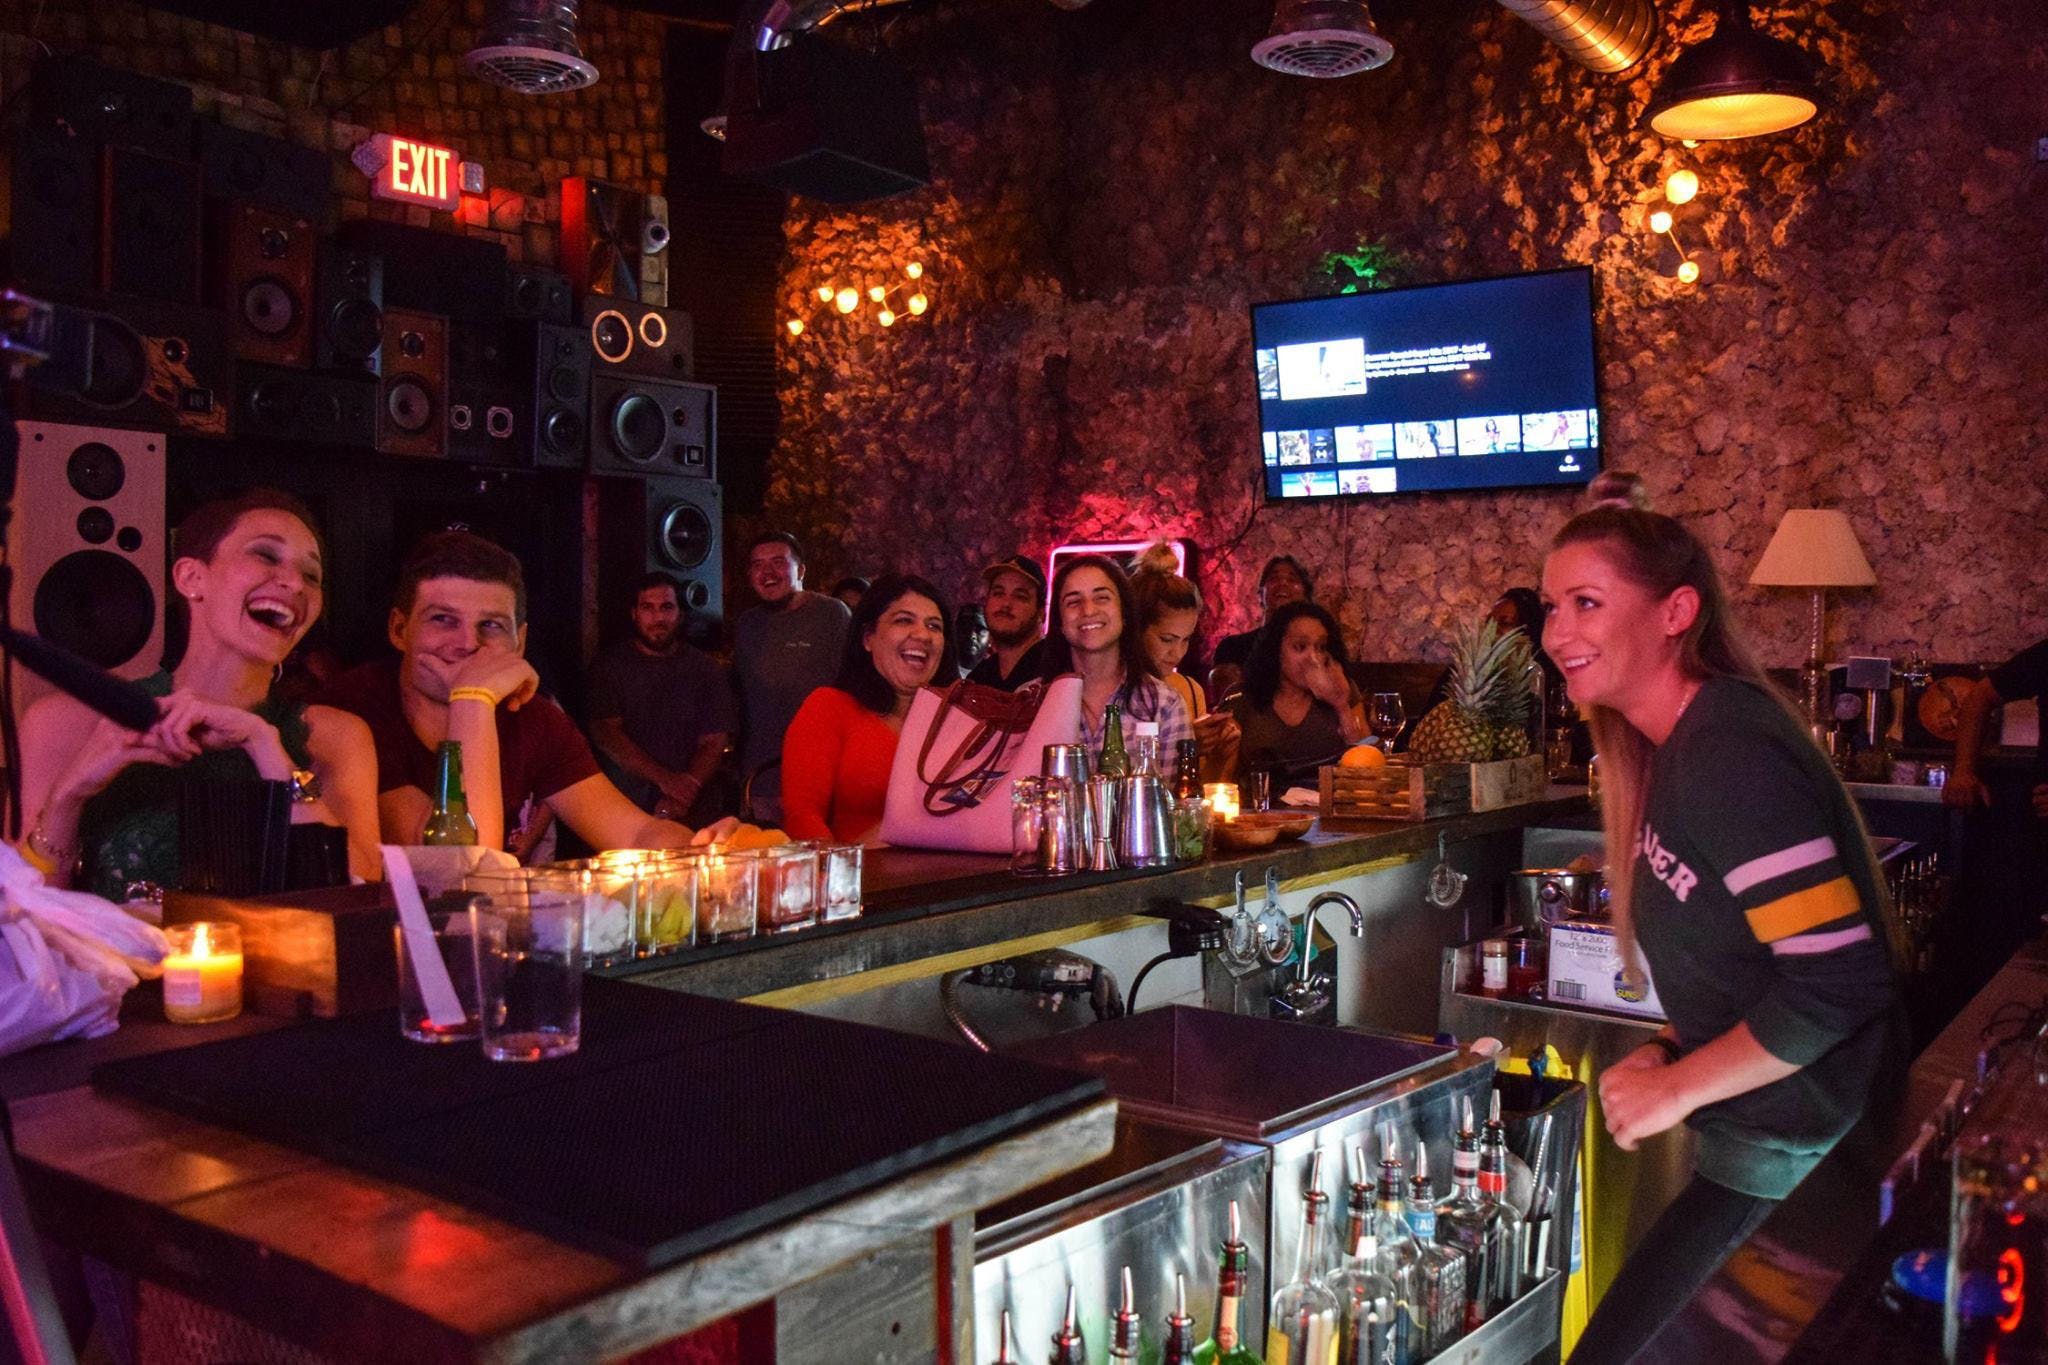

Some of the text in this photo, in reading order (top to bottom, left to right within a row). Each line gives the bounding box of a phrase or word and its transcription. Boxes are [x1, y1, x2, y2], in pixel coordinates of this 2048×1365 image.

[392, 139, 450, 200] EXIT
[1643, 823, 1698, 902] VER
[1555, 940, 1575, 949] Food
[1576, 941, 1604, 953] Service
